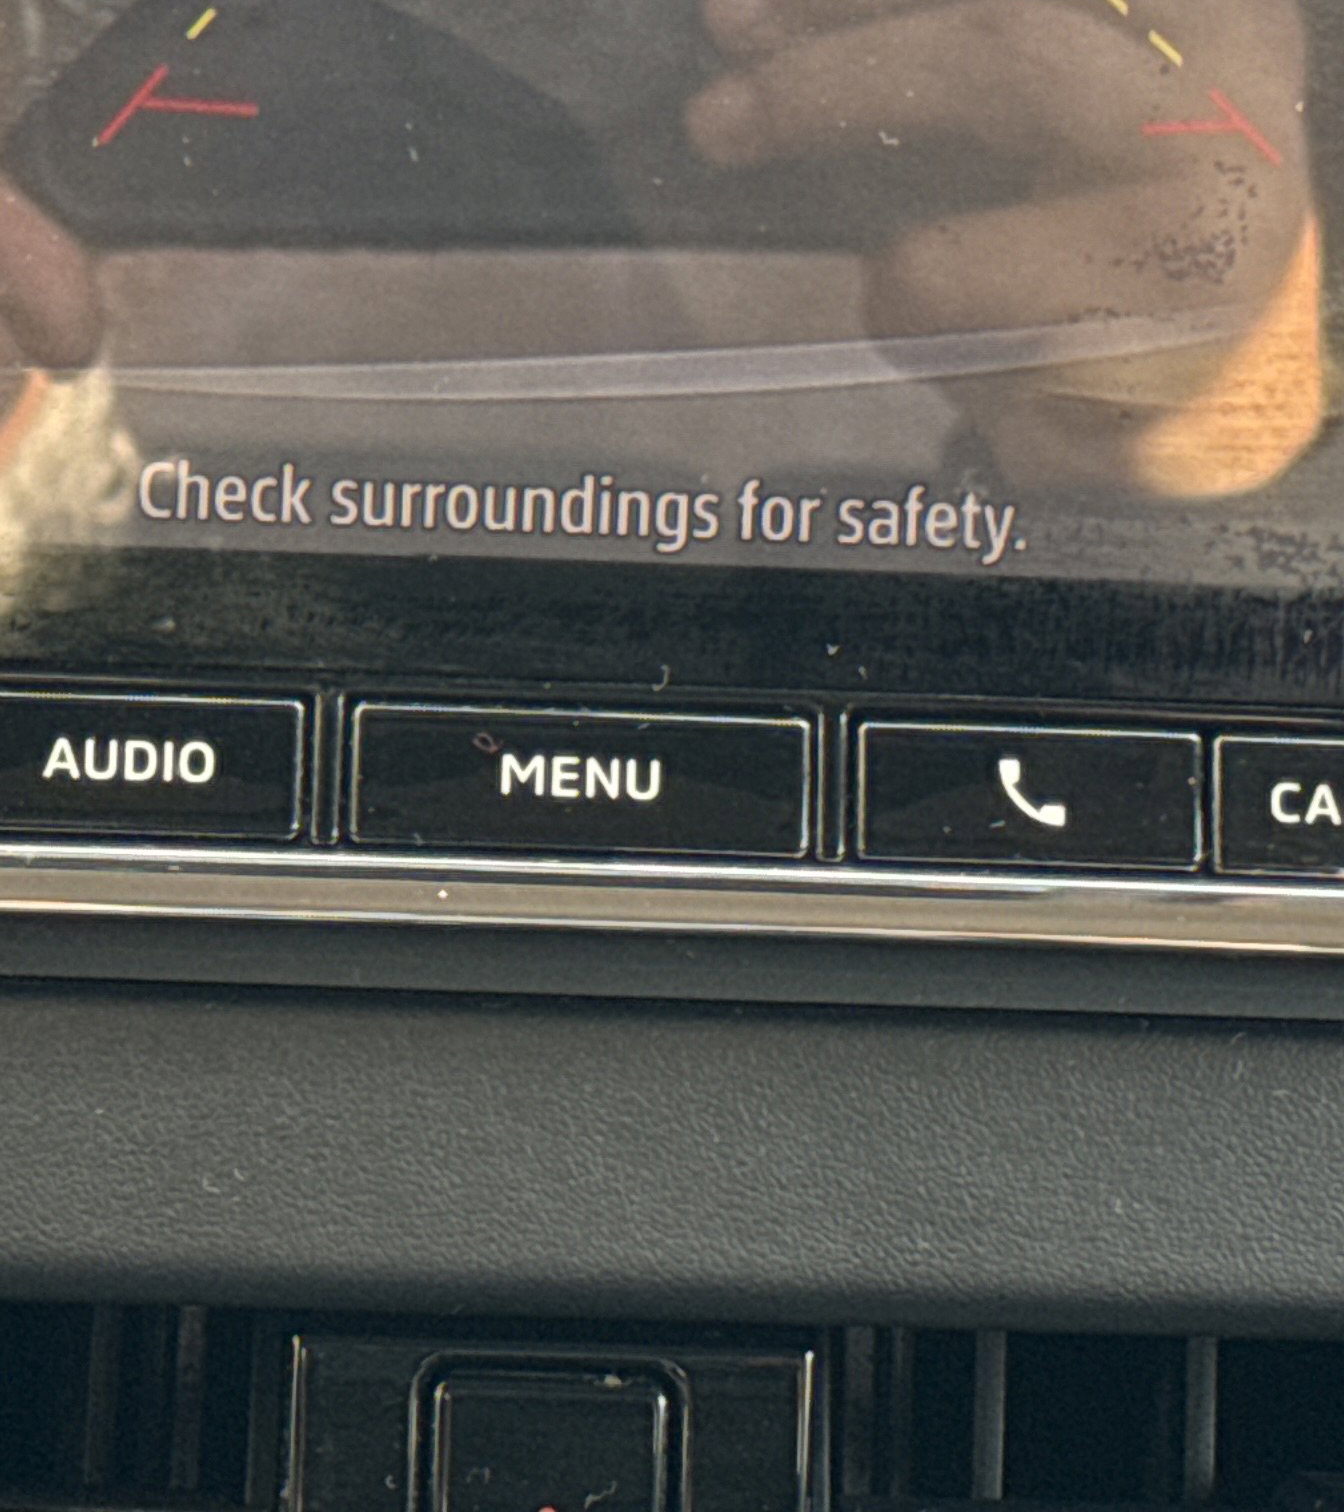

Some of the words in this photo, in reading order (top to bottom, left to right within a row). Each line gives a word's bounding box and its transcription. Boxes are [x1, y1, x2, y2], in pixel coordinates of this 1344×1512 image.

[139, 458, 312, 525] Check
[329, 474, 720, 553] surroundings
[737, 478, 822, 544] for
[836, 484, 1028, 566] safety.
[42, 736, 216, 784] AUDIO
[499, 753, 662, 801] MENU
